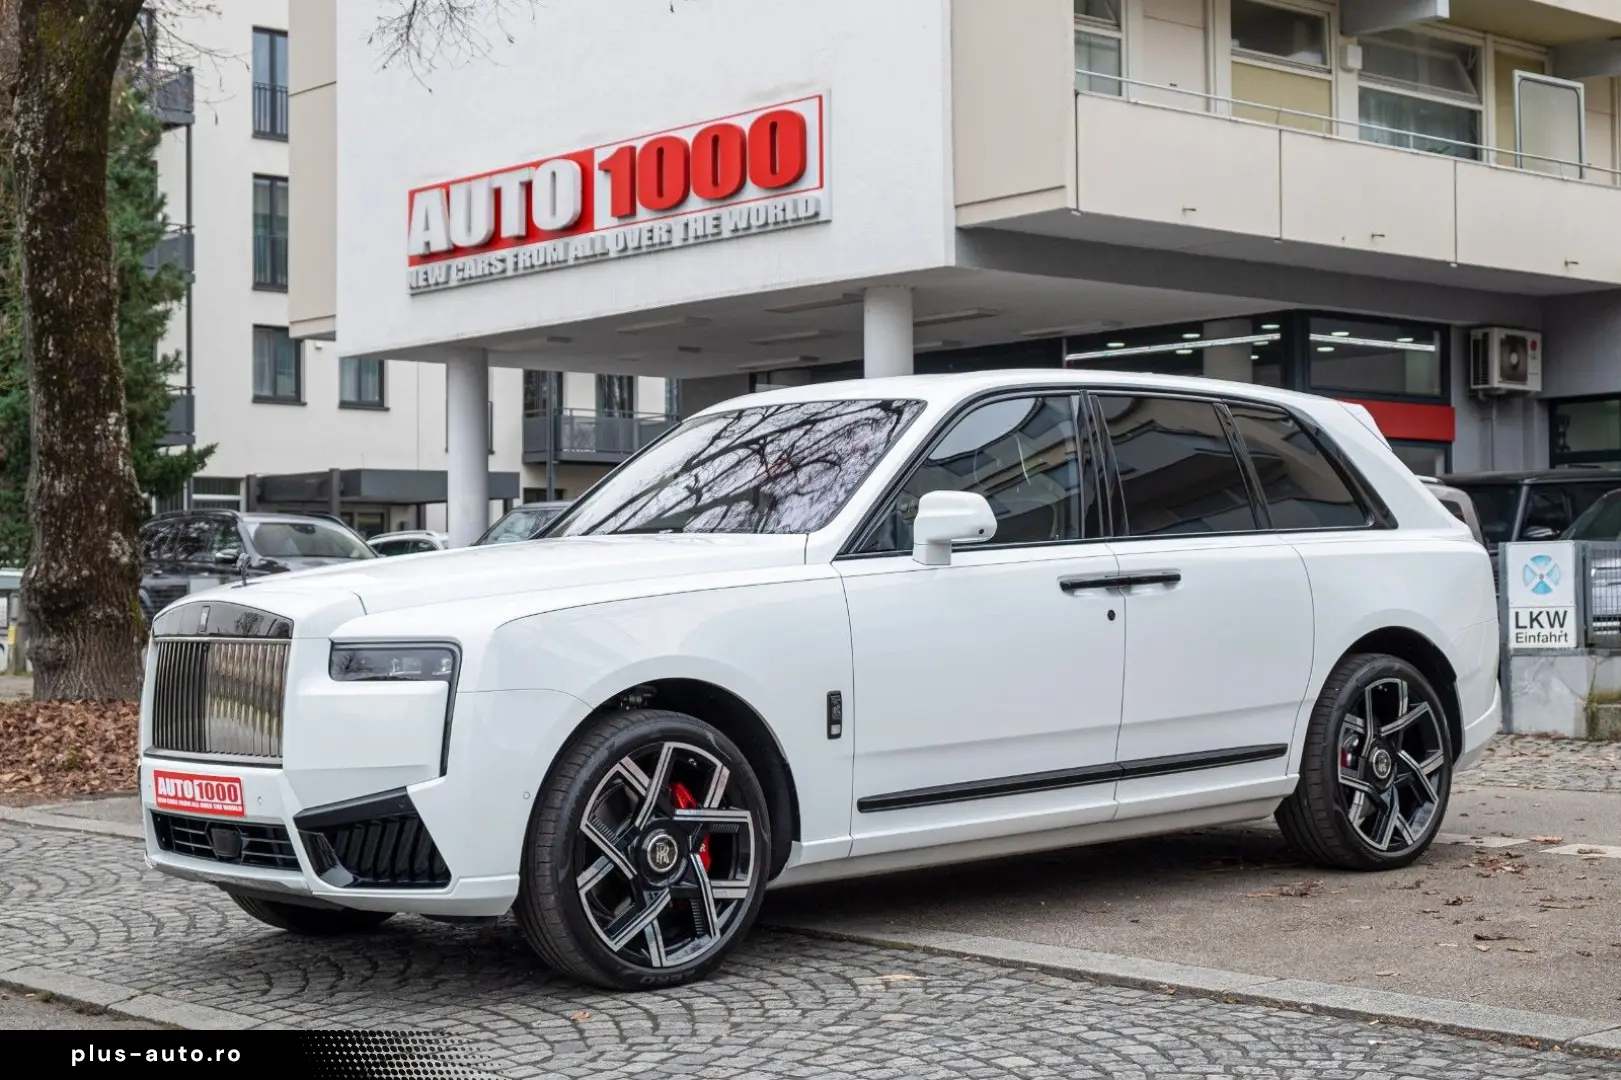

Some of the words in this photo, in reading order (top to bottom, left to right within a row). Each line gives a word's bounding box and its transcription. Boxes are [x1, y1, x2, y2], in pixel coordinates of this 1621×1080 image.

[408, 158, 582, 256] AUTO
[597, 109, 807, 218] 1000
[408, 264, 448, 290] NEW
[452, 255, 506, 281] CARS
[509, 246, 563, 271] FROM
[570, 235, 609, 260] ALL
[612, 222, 672, 252] OVER
[675, 213, 722, 241] THE
[727, 197, 821, 232] WORLD
[1515, 610, 1568, 629] LKW
[1515, 630, 1568, 643] Einfahrt
[157, 776, 193, 799] AUTO
[196, 782, 239, 802] 1000
